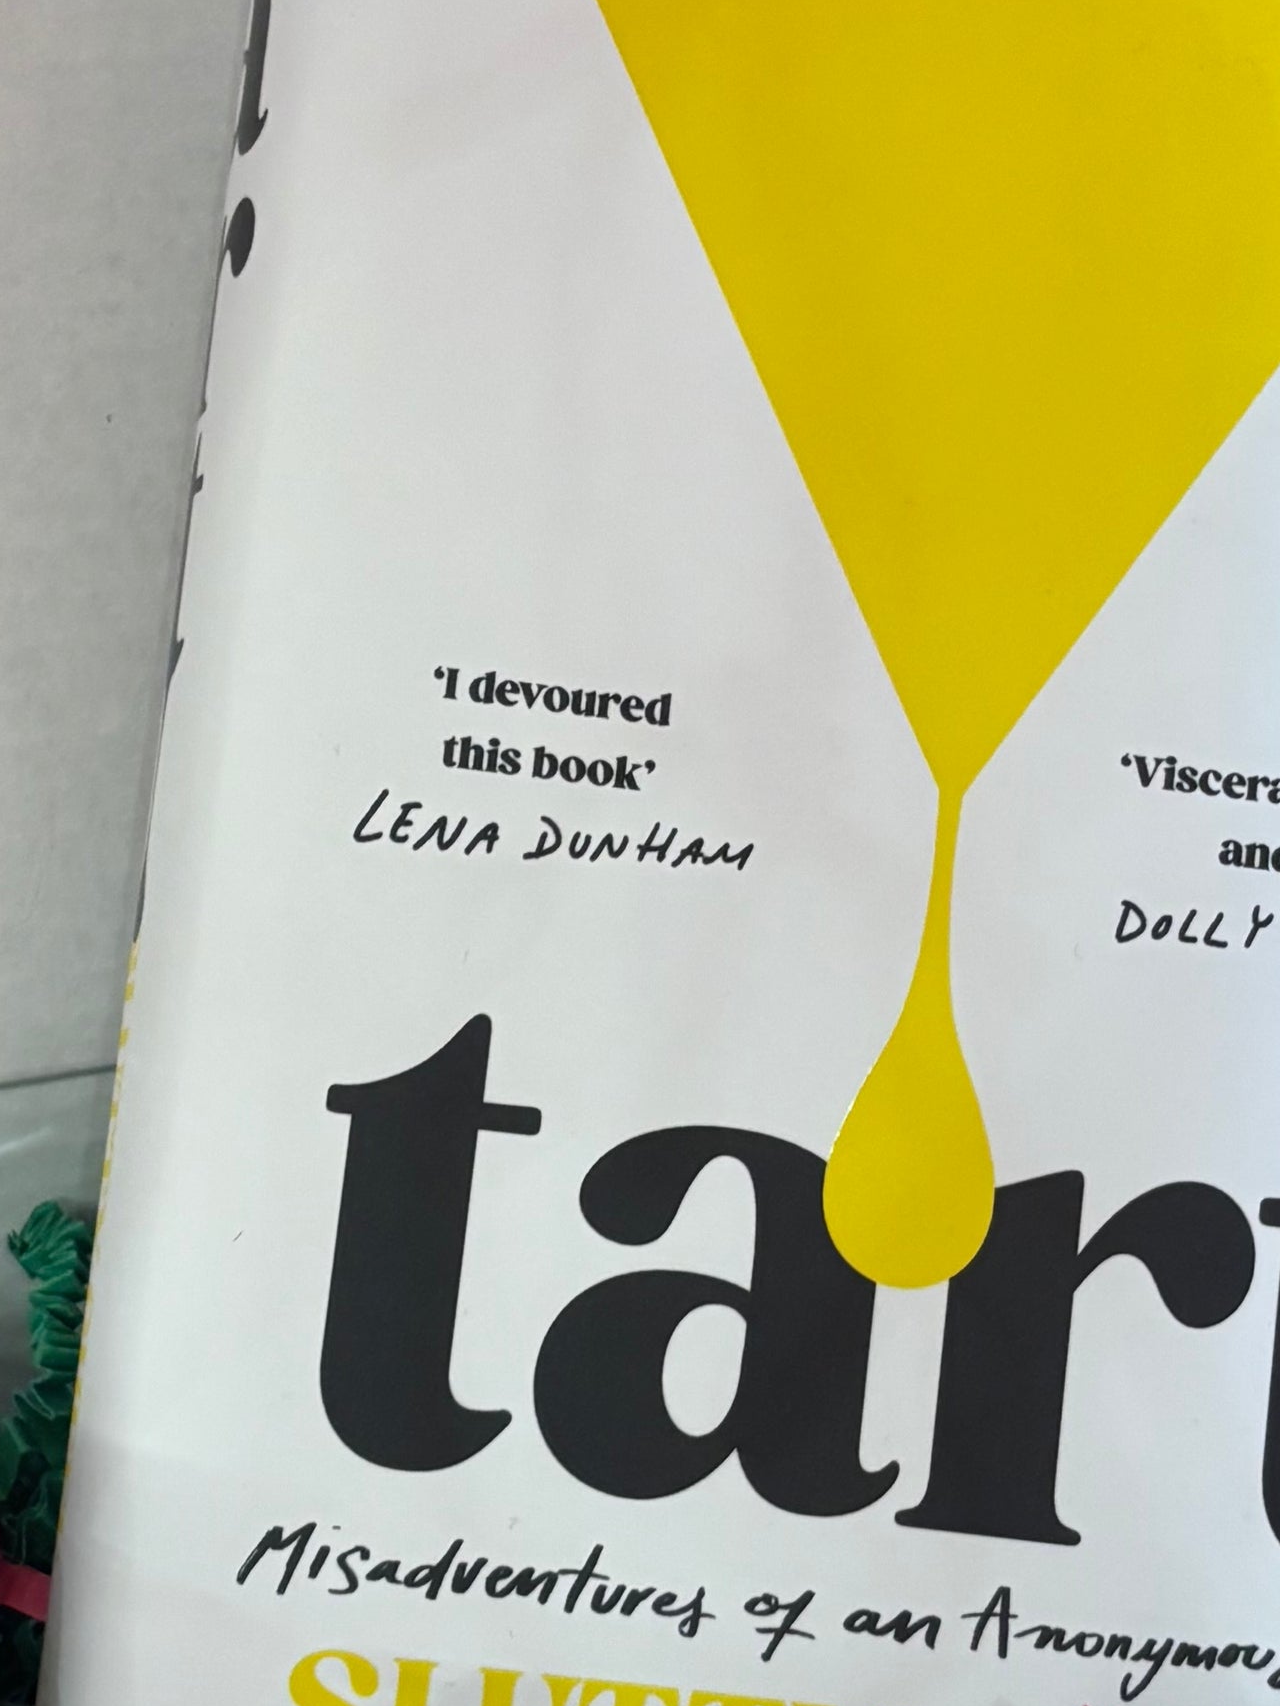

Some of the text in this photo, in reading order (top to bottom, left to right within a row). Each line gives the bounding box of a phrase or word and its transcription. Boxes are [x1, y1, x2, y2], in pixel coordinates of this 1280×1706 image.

[468, 671, 672, 726] devoured
[442, 736, 656, 791] this book’
[353, 789, 754, 871] LENA DUNHAM
[1115, 899, 1274, 949] DOLLY
[236, 1521, 716, 1637] Misadventures
[743, 1590, 816, 1662] of
[842, 1608, 942, 1648] an
